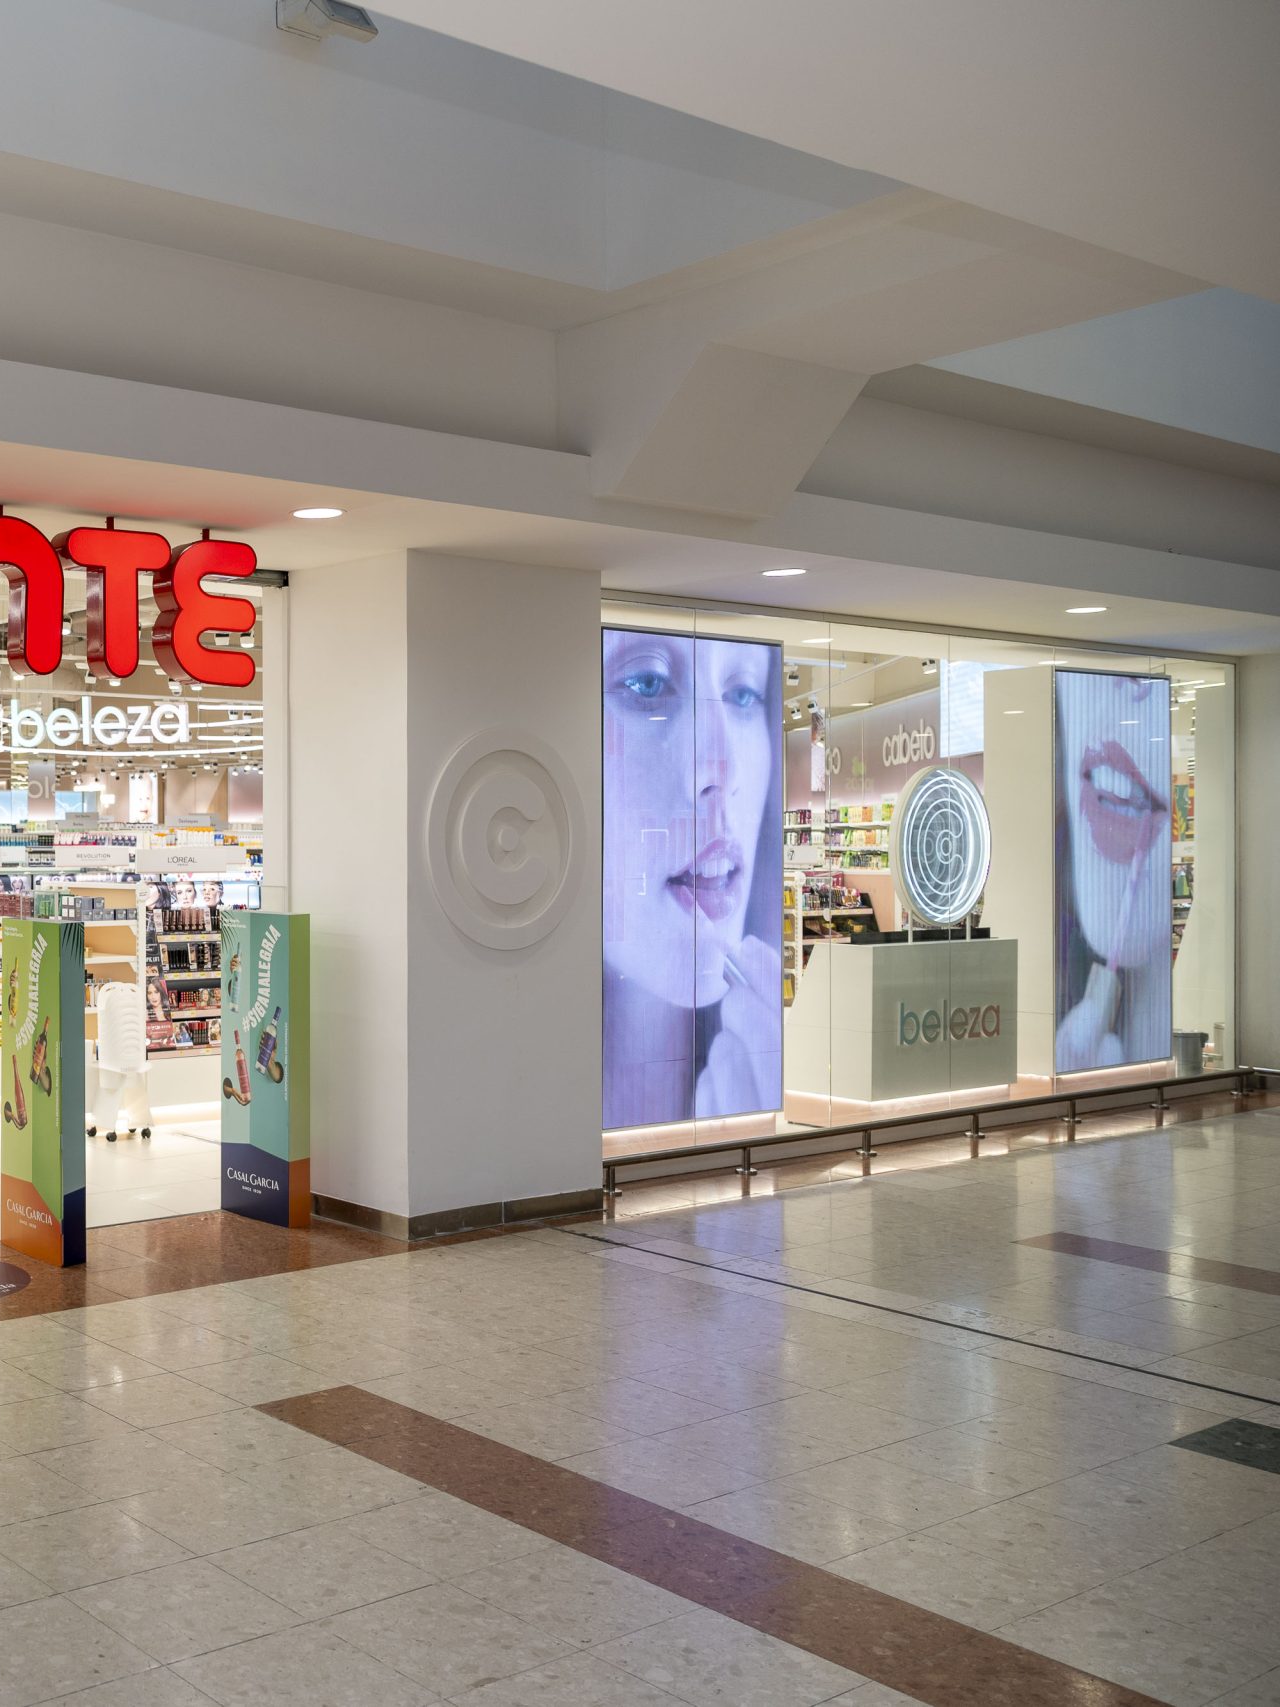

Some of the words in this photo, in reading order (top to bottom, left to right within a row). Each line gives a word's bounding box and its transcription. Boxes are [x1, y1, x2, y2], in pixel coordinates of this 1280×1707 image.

[10, 695, 190, 748] beleza
[882, 718, 936, 767] cabelo
[15, 932, 48, 1051] #SIGAAALEGRIA
[242, 923, 281, 1033] #SIGAAALEGRIA
[897, 999, 1001, 1046] beleza
[227, 1167, 250, 1183] CASAL
[249, 1173, 280, 1191] GARCIA
[6, 1198, 26, 1216] CASAL
[25, 1206, 53, 1227] GARCIA
